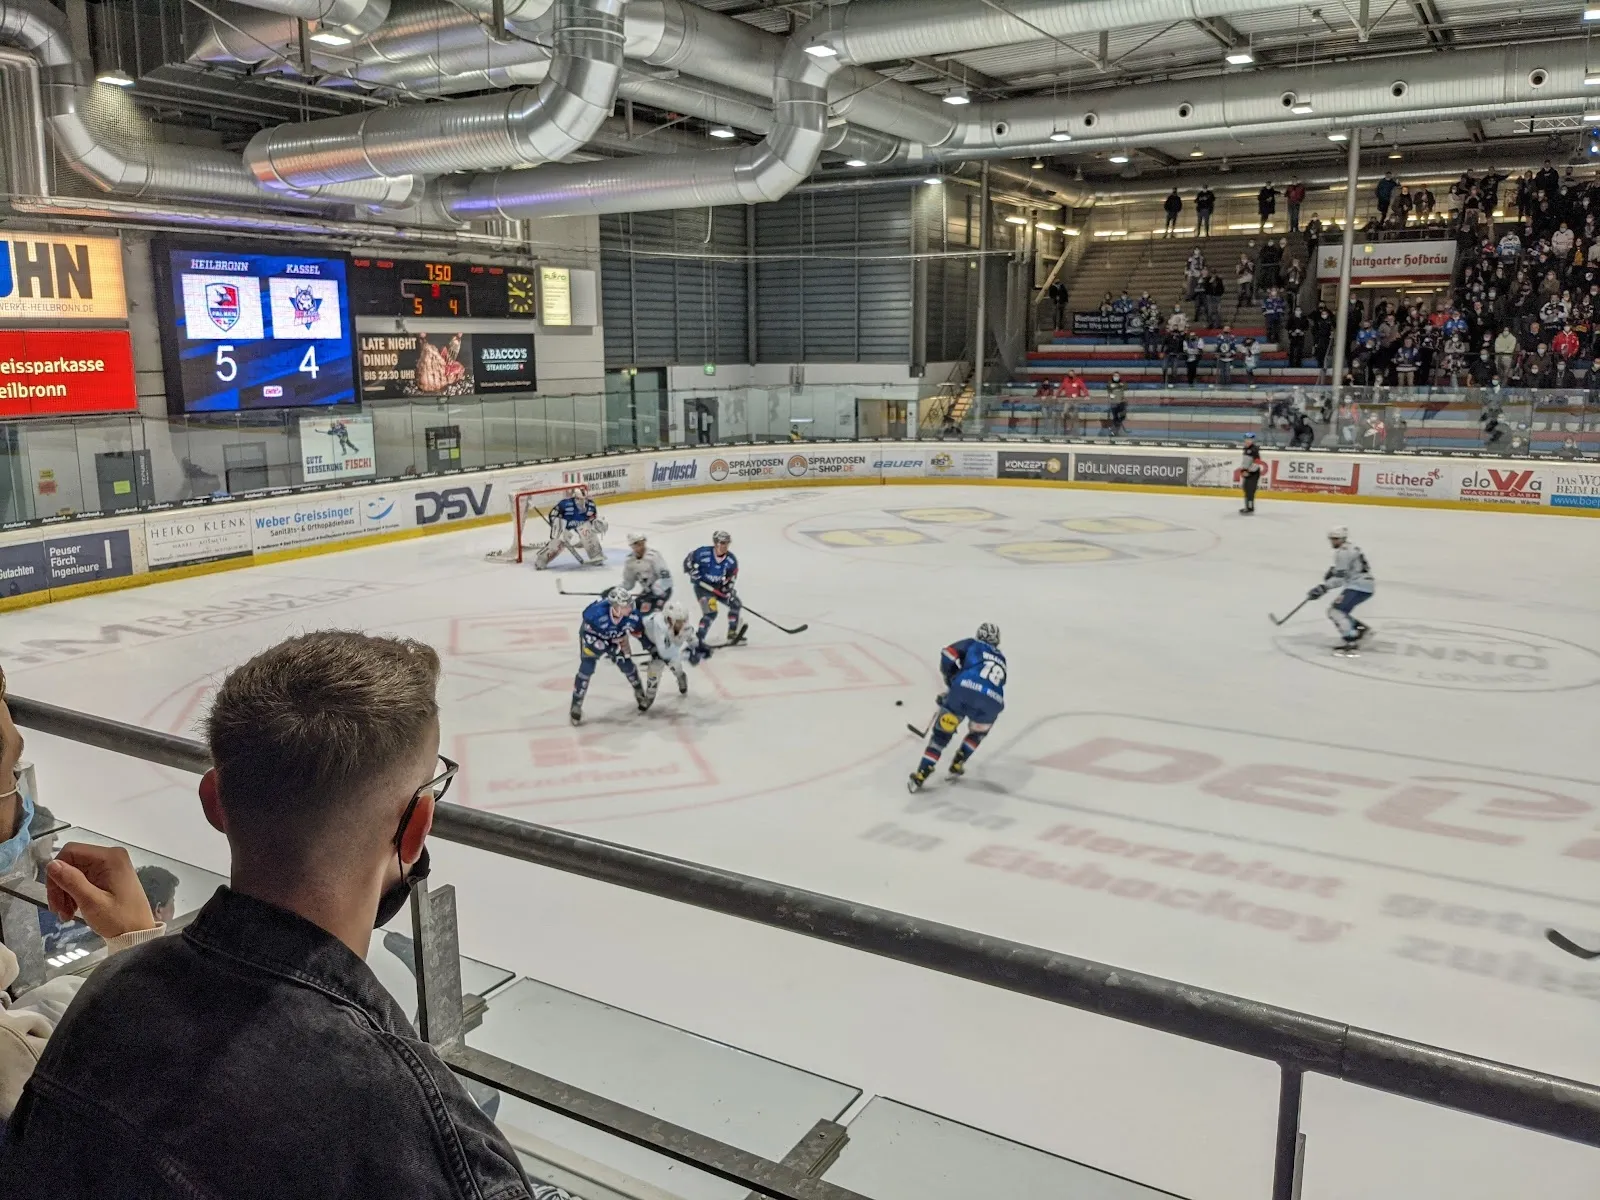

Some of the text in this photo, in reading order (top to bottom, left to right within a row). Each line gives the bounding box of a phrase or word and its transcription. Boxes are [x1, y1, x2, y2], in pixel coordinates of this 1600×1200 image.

[190, 259, 249, 271] HEILBRONN
[1351, 256, 1401, 268] tuttgarter
[286, 264, 321, 275] KASSEL
[414, 297, 423, 315] 5
[448, 299, 458, 315] 4
[362, 337, 417, 351] LATE NIGHT
[363, 352, 399, 367] DINING
[482, 348, 528, 360] ABACCO'S
[0, 356, 105, 375] eissparkasse
[216, 345, 238, 382] 5
[299, 345, 320, 379] 4
[364, 370, 416, 381] BIS 23:30 UHR
[0, 382, 67, 398] eilbronn
[306, 455, 323, 466] GUTE
[729, 456, 784, 468] SPRAYDOSEN
[808, 456, 866, 465] SPRAYDOSEN
[1005, 460, 1047, 469] KONZEPT
[1288, 461, 1315, 473] SER
[306, 462, 344, 475] BESSERUNG
[1077, 461, 1141, 476] BÖLLINGER
[1143, 464, 1184, 477] GROUP
[1376, 473, 1434, 487] Elithera
[1556, 477, 1577, 485] DAS
[1556, 485, 1588, 495] BEIM
[414, 483, 493, 526] DSV
[255, 506, 354, 529] Weber Greissinger
[150, 517, 246, 539] HEIKO KLENK
[50, 545, 81, 557] Peuser
[50, 555, 77, 567] Förch
[52, 563, 100, 579] Ingenieure
[979, 661, 1005, 686] 78
